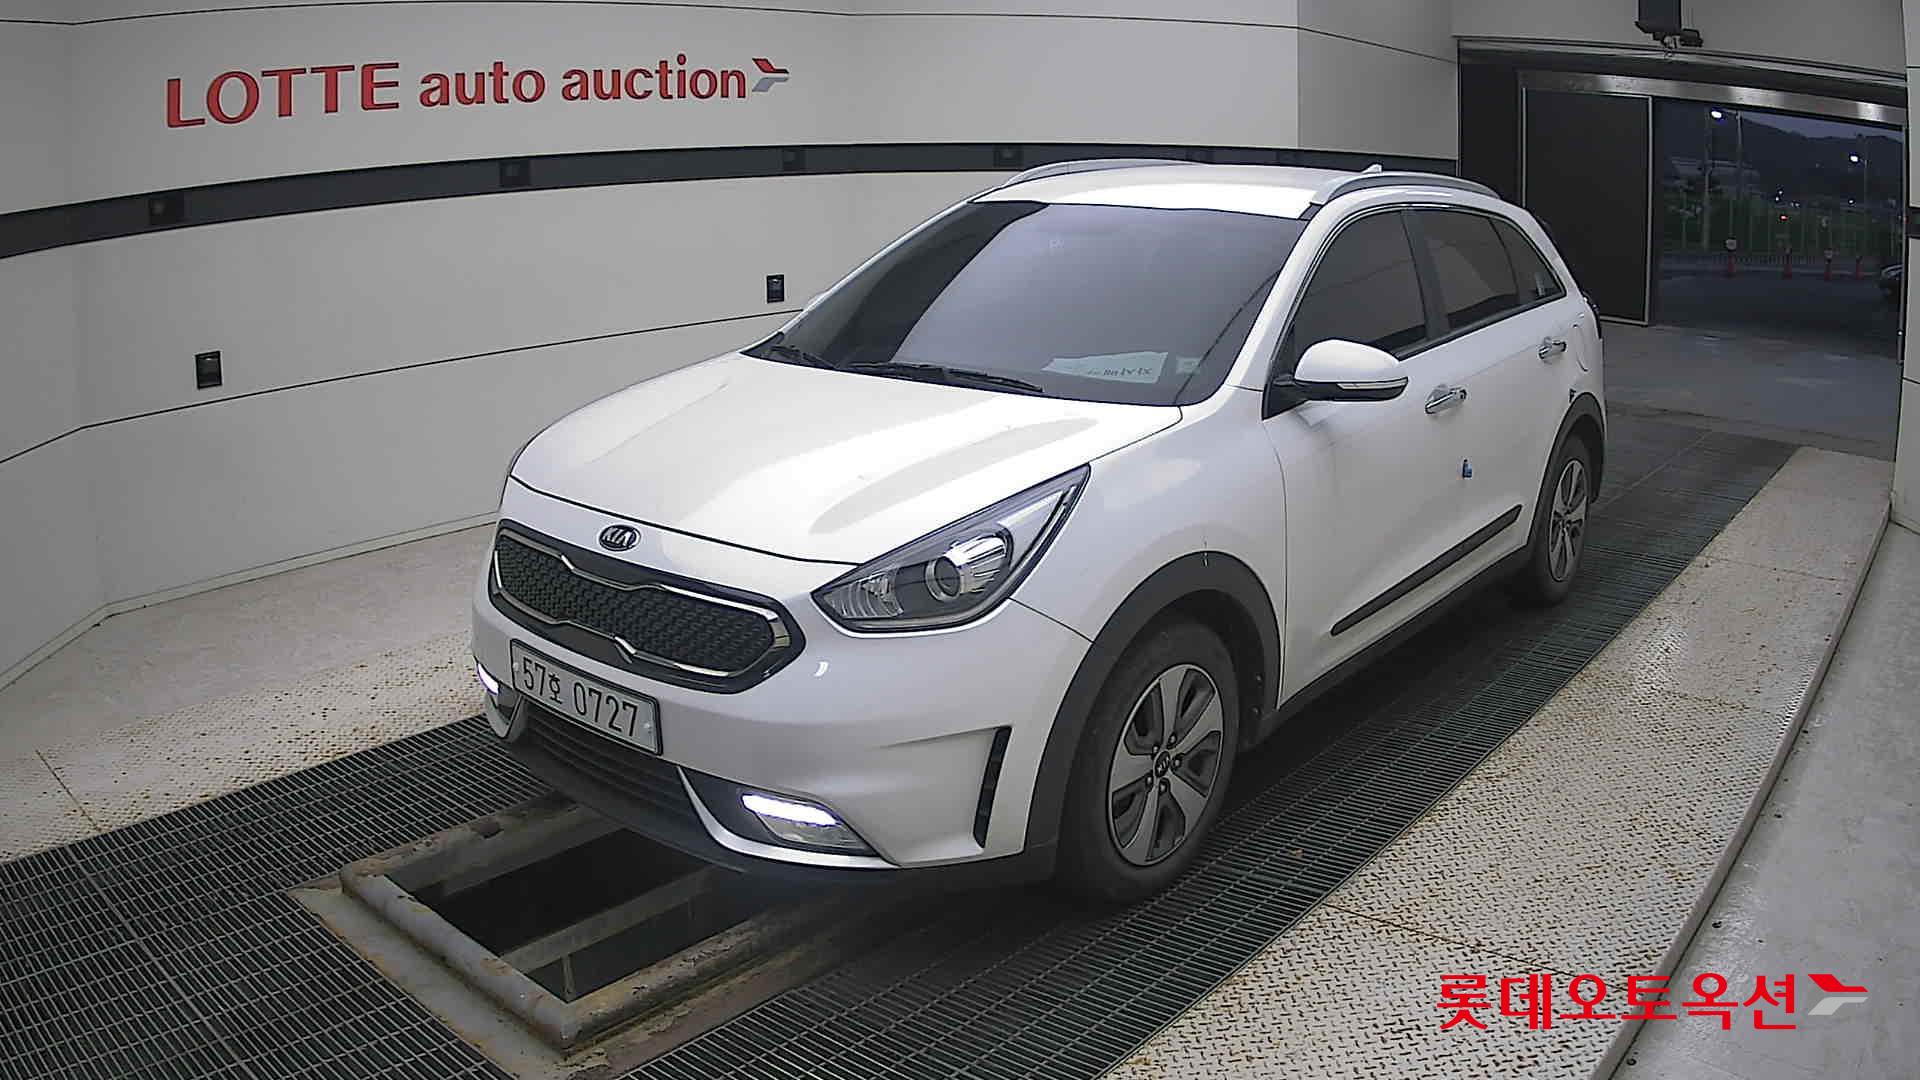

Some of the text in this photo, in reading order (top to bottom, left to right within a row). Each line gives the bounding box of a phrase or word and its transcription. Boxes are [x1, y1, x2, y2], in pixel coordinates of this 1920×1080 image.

[165, 53, 748, 128] LOTTE auto auction
[601, 526, 635, 548] KIA
[573, 681, 638, 737] 0727
